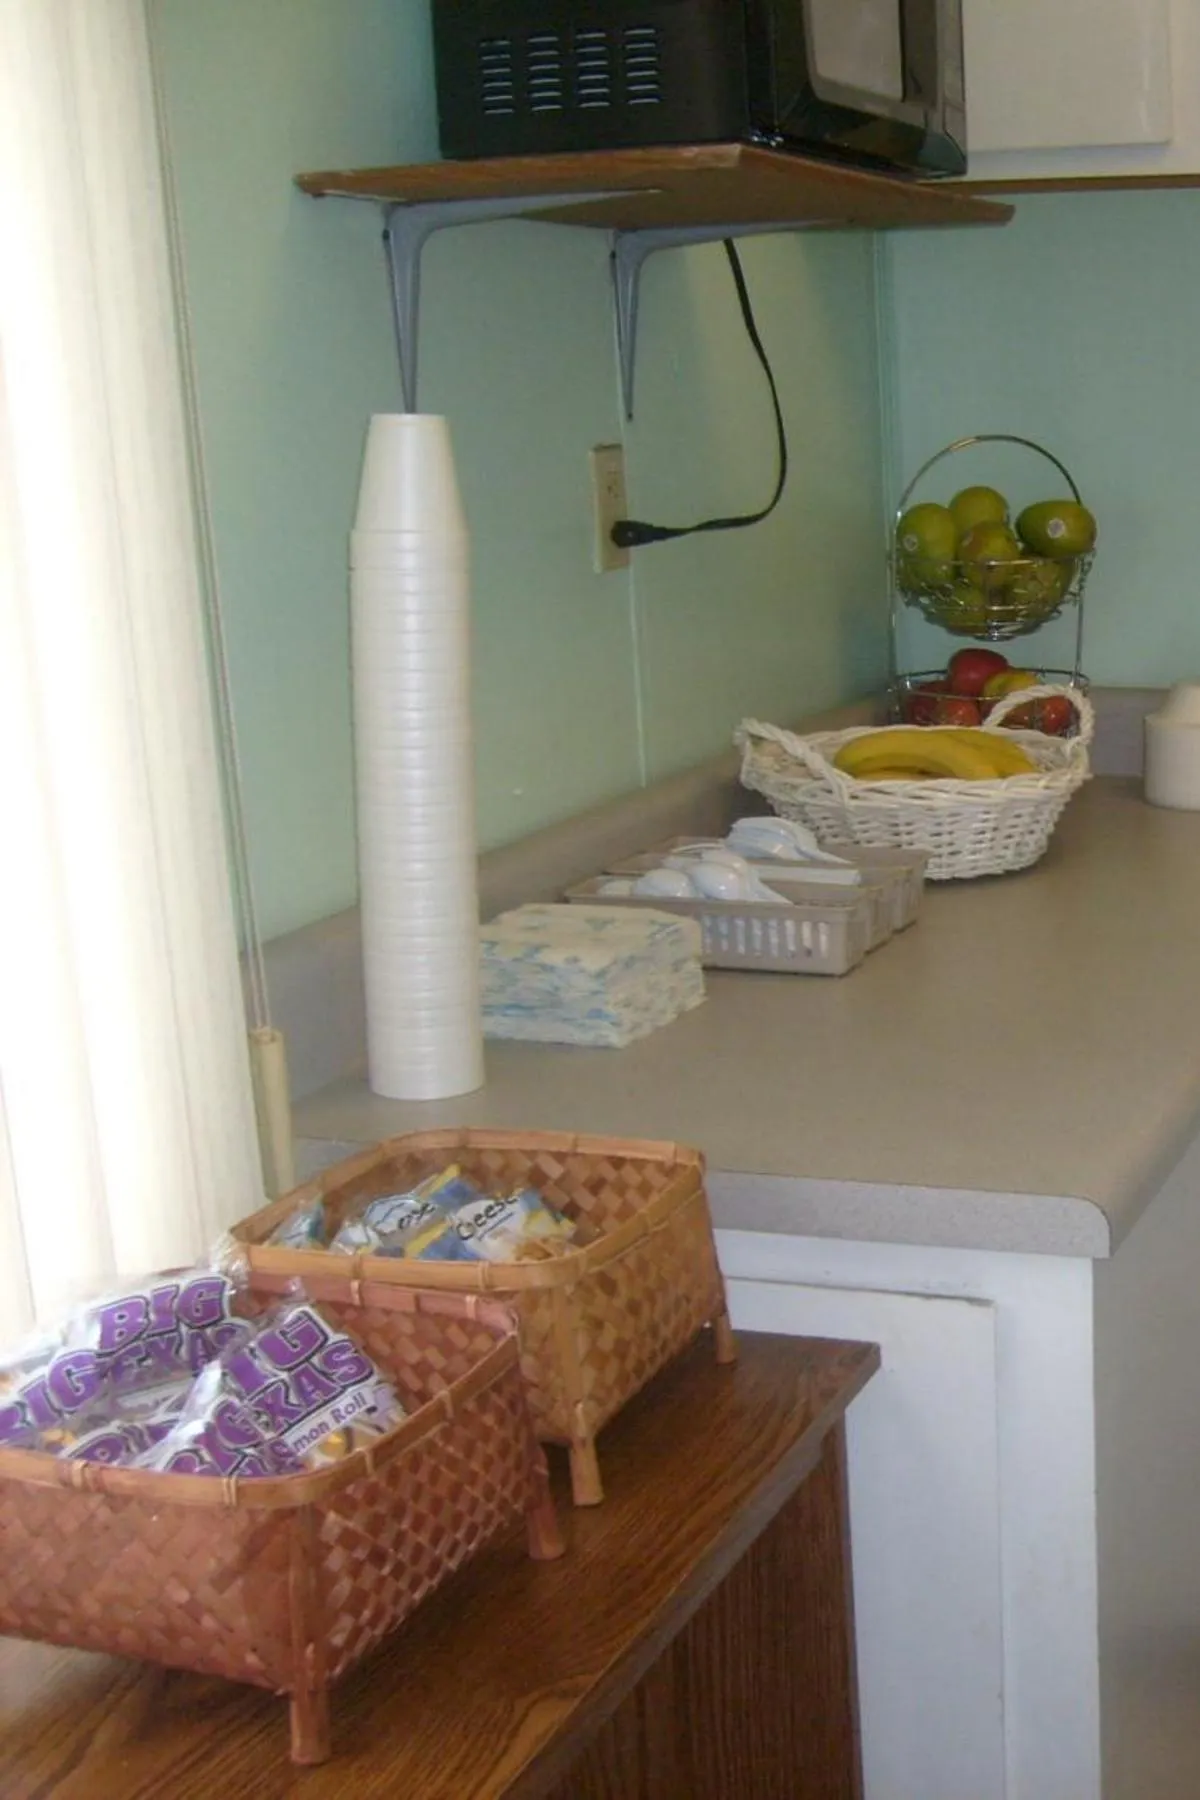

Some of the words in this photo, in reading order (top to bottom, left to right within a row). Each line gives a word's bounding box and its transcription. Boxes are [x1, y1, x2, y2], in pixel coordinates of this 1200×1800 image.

[95, 1276, 227, 1359] BIG
[226, 1309, 329, 1397] IG
[329, 1391, 368, 1424] Roll
